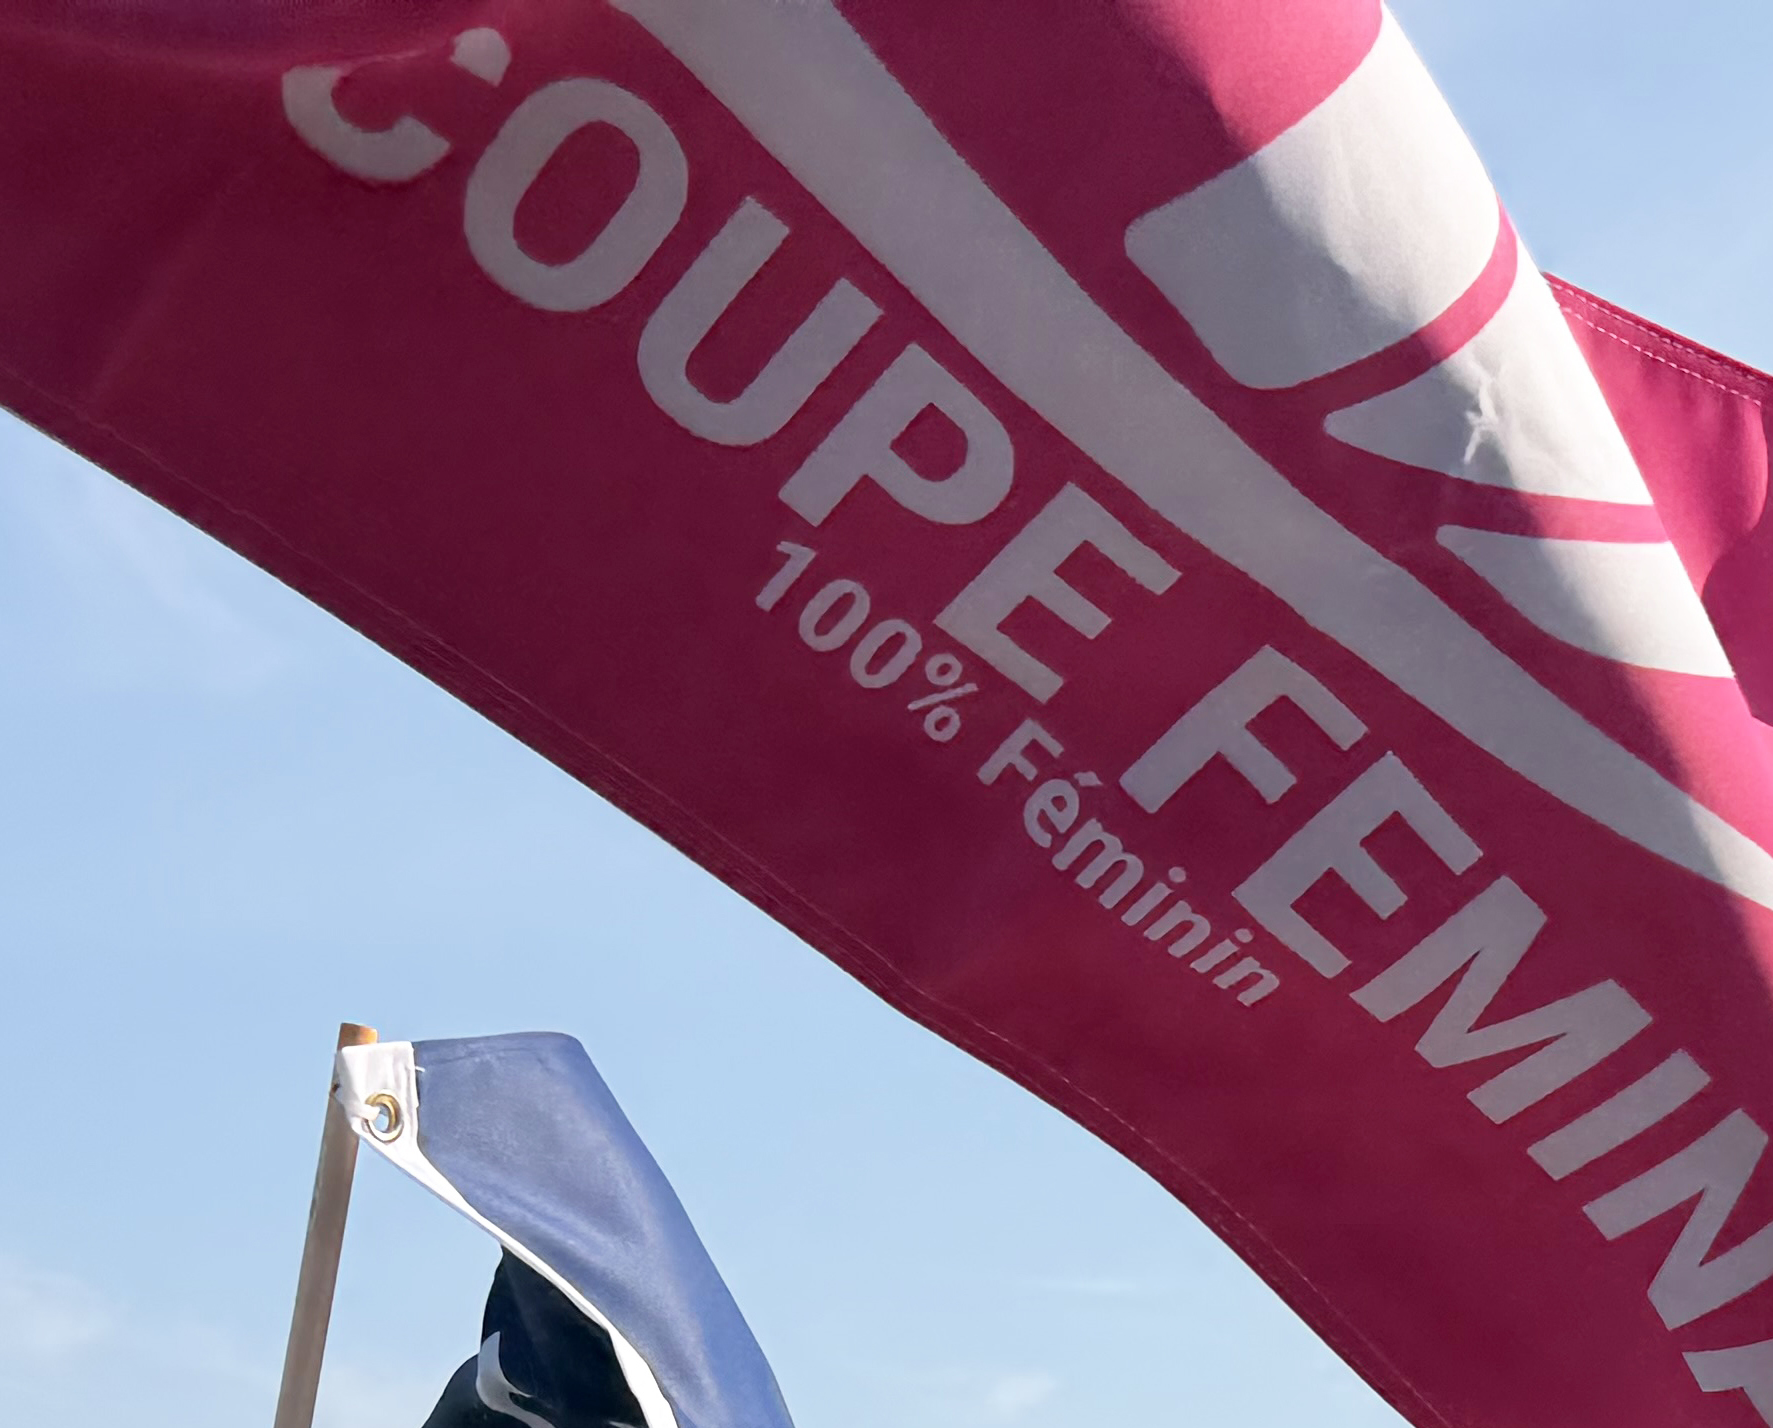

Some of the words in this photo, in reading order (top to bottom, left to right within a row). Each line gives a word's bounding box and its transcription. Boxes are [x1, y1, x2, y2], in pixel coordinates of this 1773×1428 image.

[282, 26, 1182, 703] COUPE
[755, 541, 978, 742] 100%
[977, 717, 1280, 1007] Féminin
